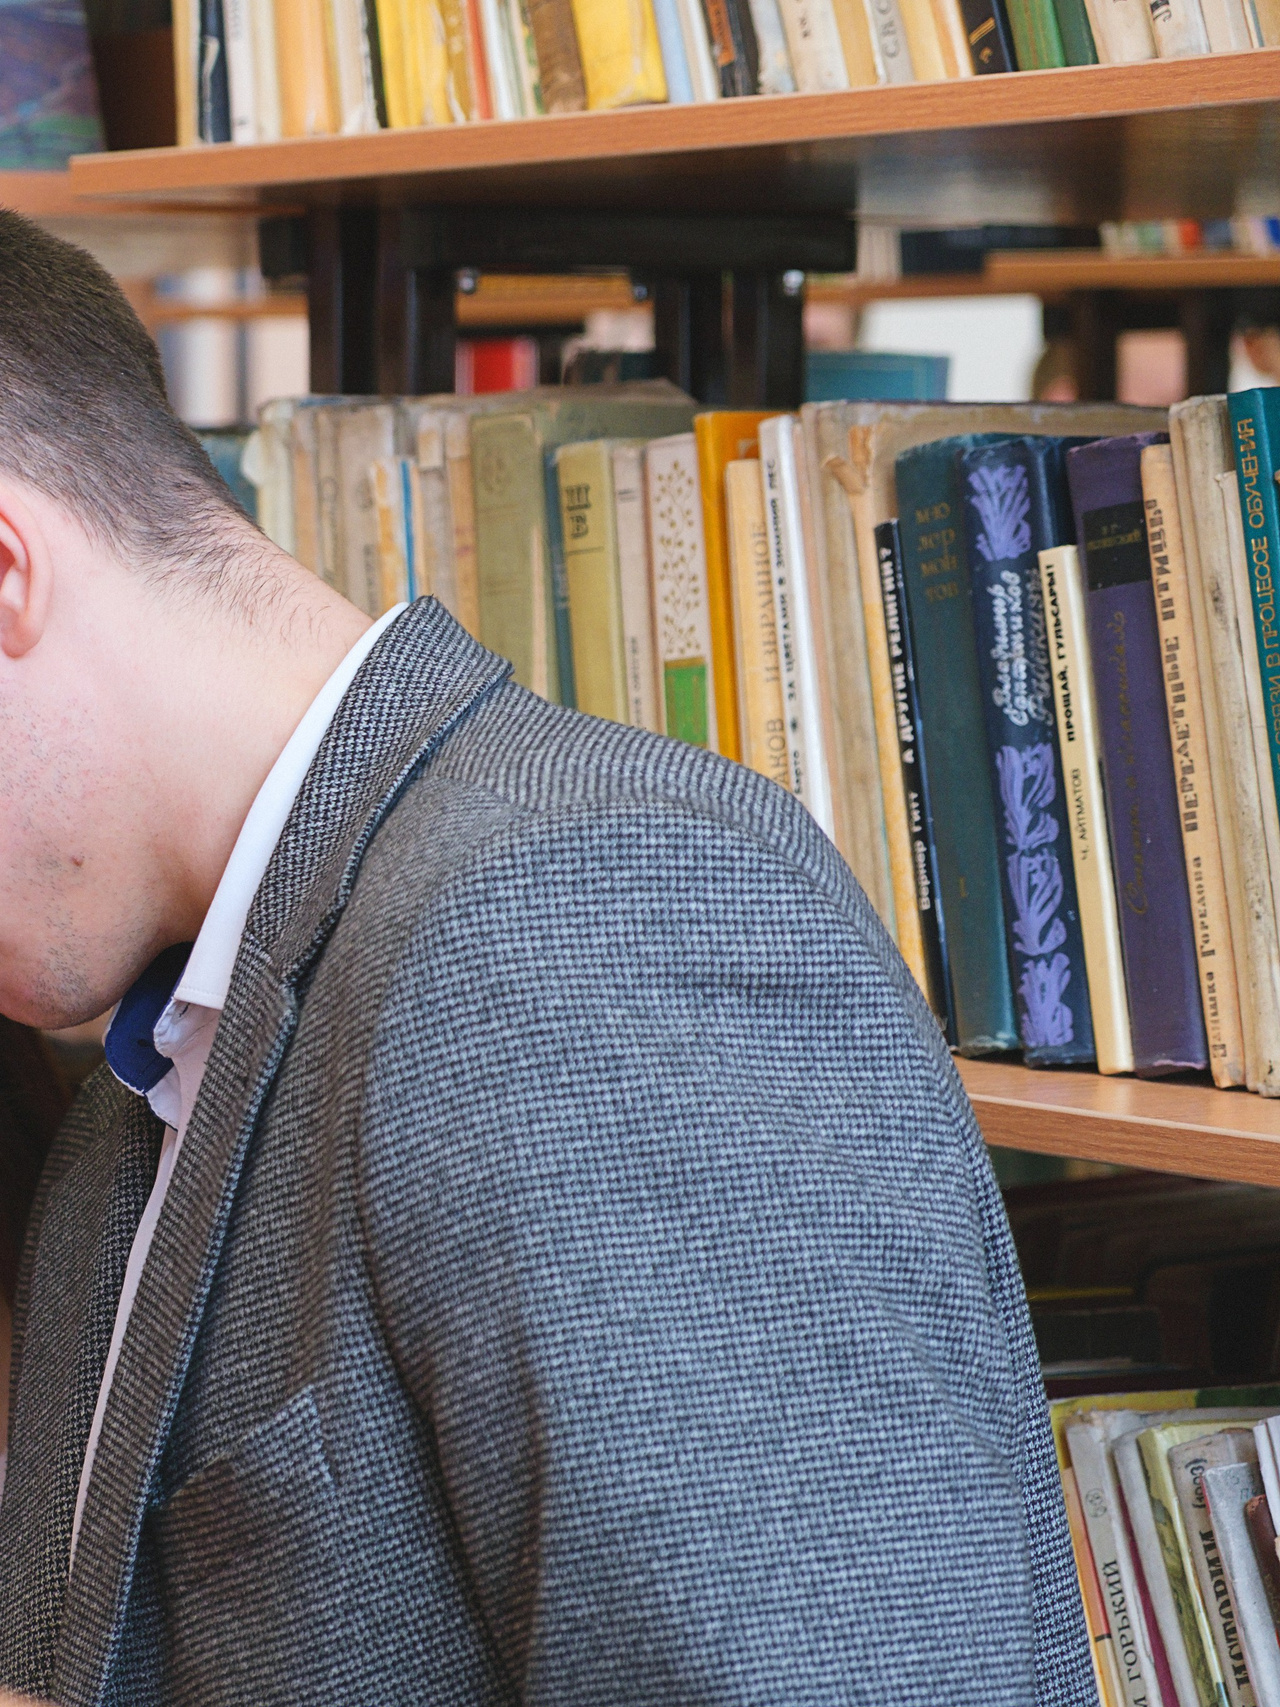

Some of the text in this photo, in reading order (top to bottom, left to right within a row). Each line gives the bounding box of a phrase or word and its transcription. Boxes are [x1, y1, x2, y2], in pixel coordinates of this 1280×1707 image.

[1237, 418, 1265, 529] ОБУЧЕНИЯ
[879, 547, 903, 658] РЕЛИГИИ?
[1045, 564, 1066, 660] ГУЛЬСАРЫ!
[1251, 536, 1280, 649] ПРОЦЕССЕ
[780, 593, 795, 673] ЦВЕТАМИ
[787, 680, 796, 700] ЗА
[893, 662, 915, 743] ДРУГИЕ
[1057, 665, 1076, 742] ПРОЩАЙ,
[903, 749, 915, 764] А
[1072, 768, 1089, 840] АЙТМАТОВ
[914, 841, 931, 910] Вернер
[1103, 1560, 1142, 1683] ГОРЬКИЙ
